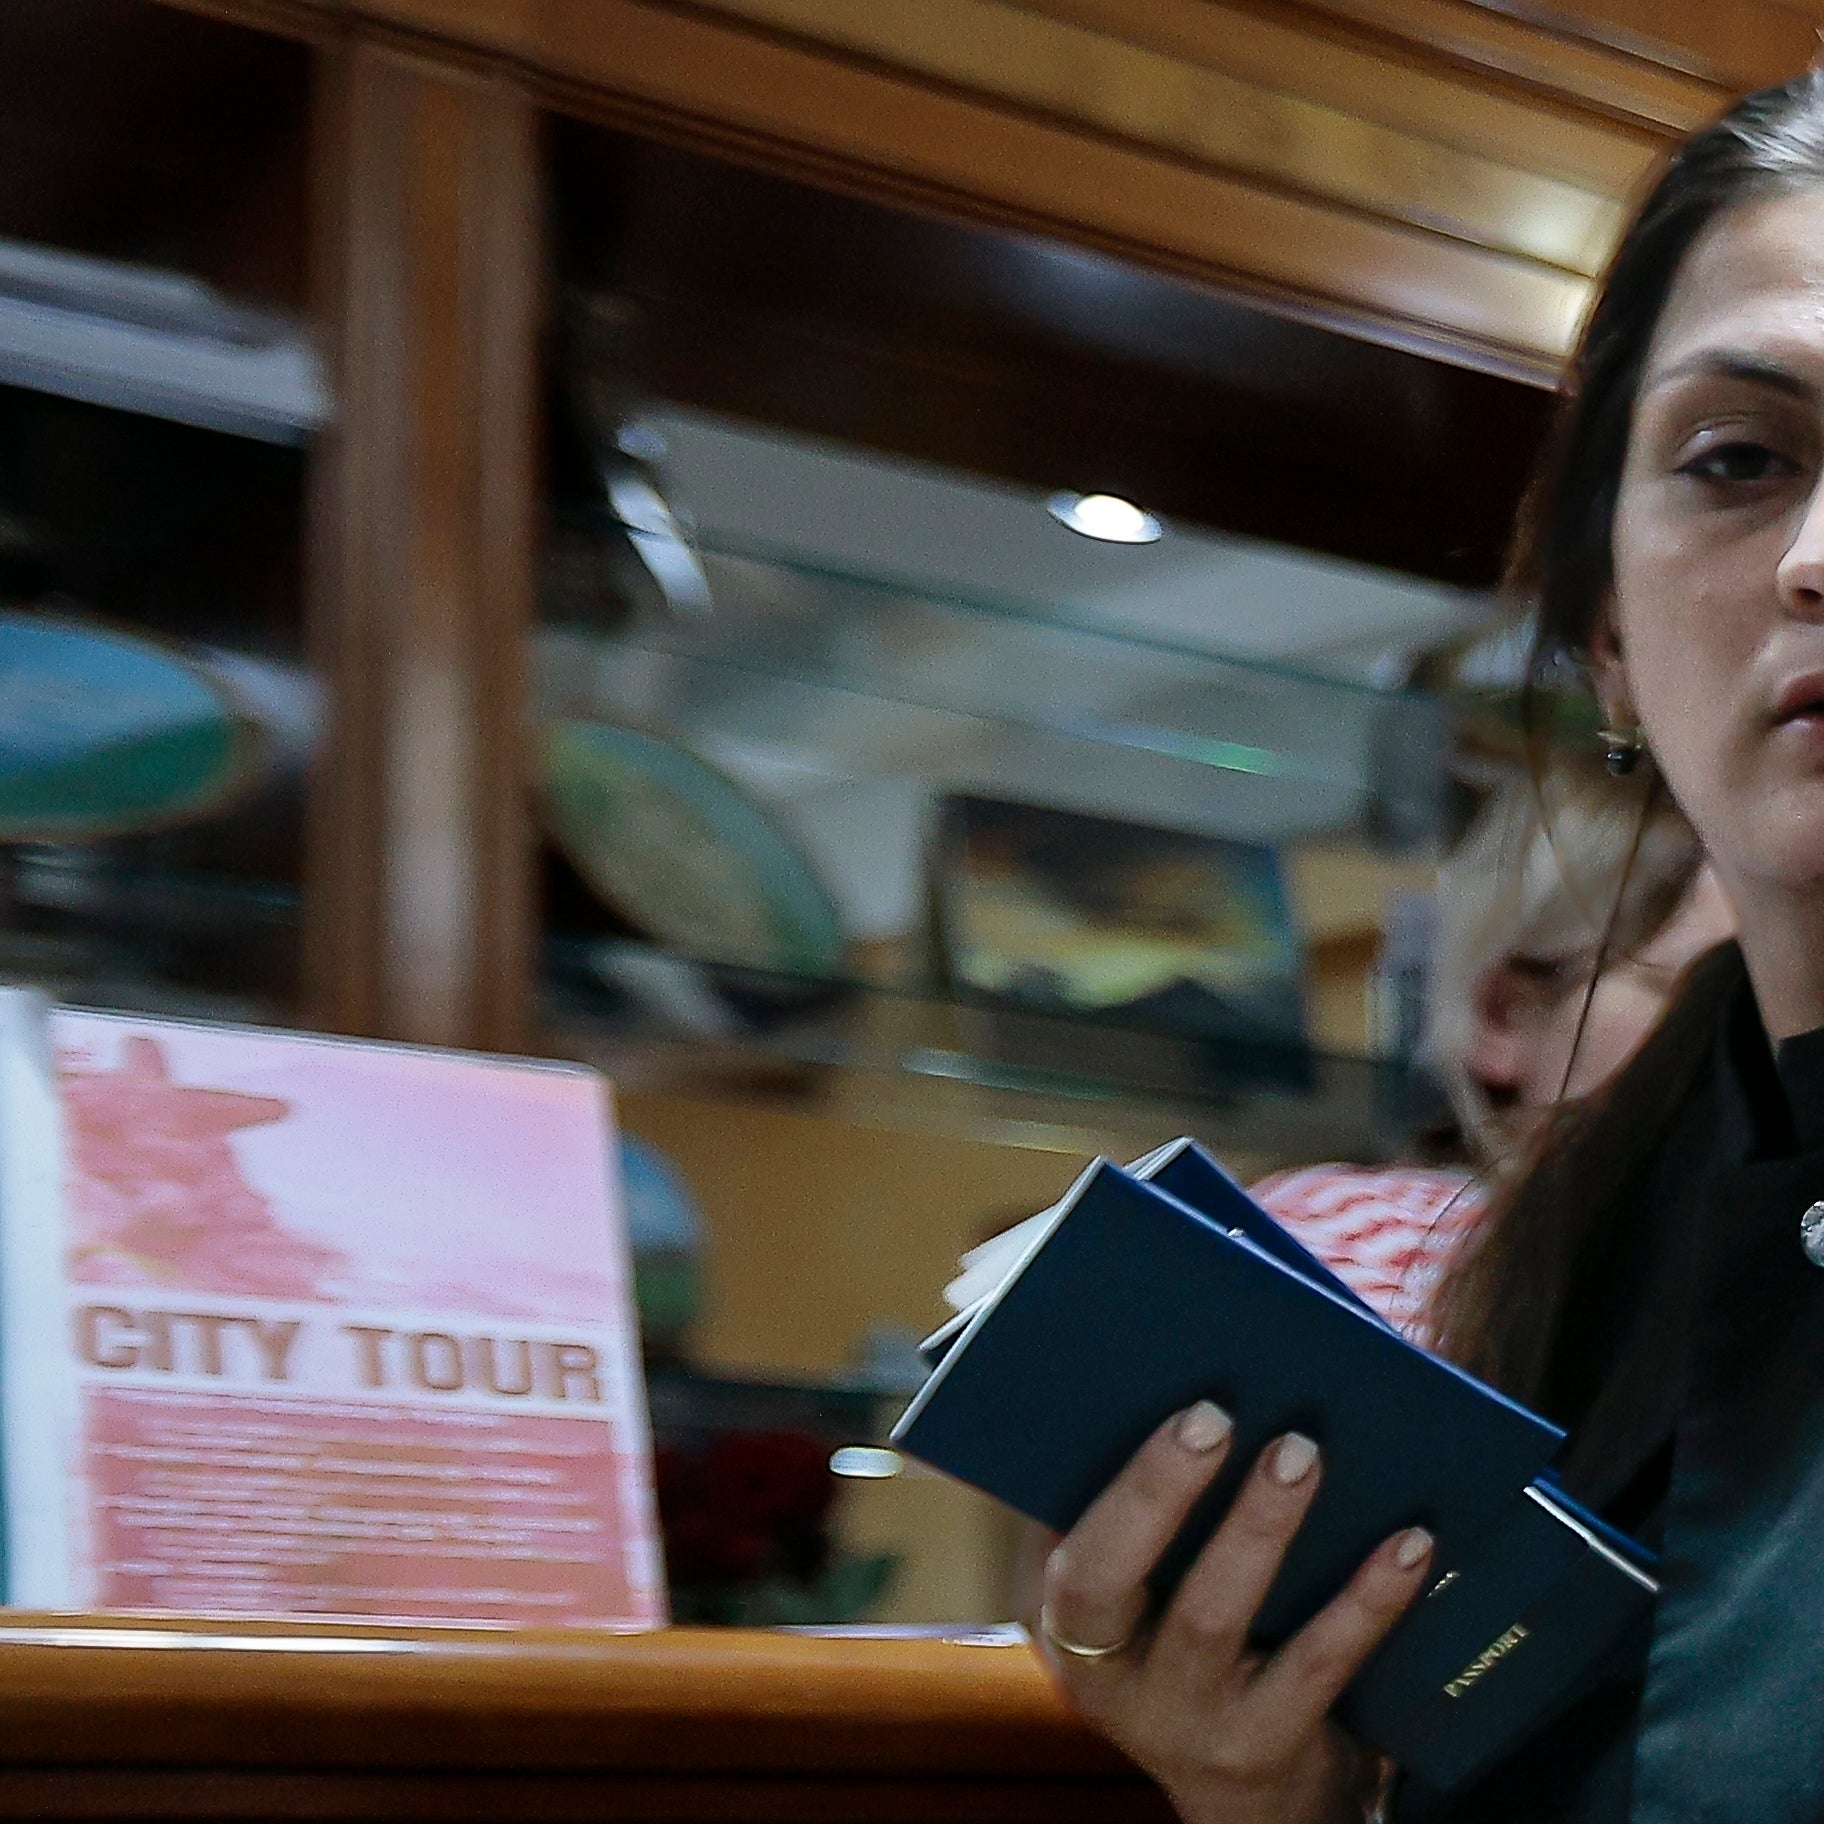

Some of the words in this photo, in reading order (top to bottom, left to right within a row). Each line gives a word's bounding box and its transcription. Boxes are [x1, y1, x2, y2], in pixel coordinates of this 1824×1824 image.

[72, 1304, 302, 1380] CITY
[340, 1324, 606, 1401] TOUR
[1443, 1622, 1528, 1697] PASSPORT
